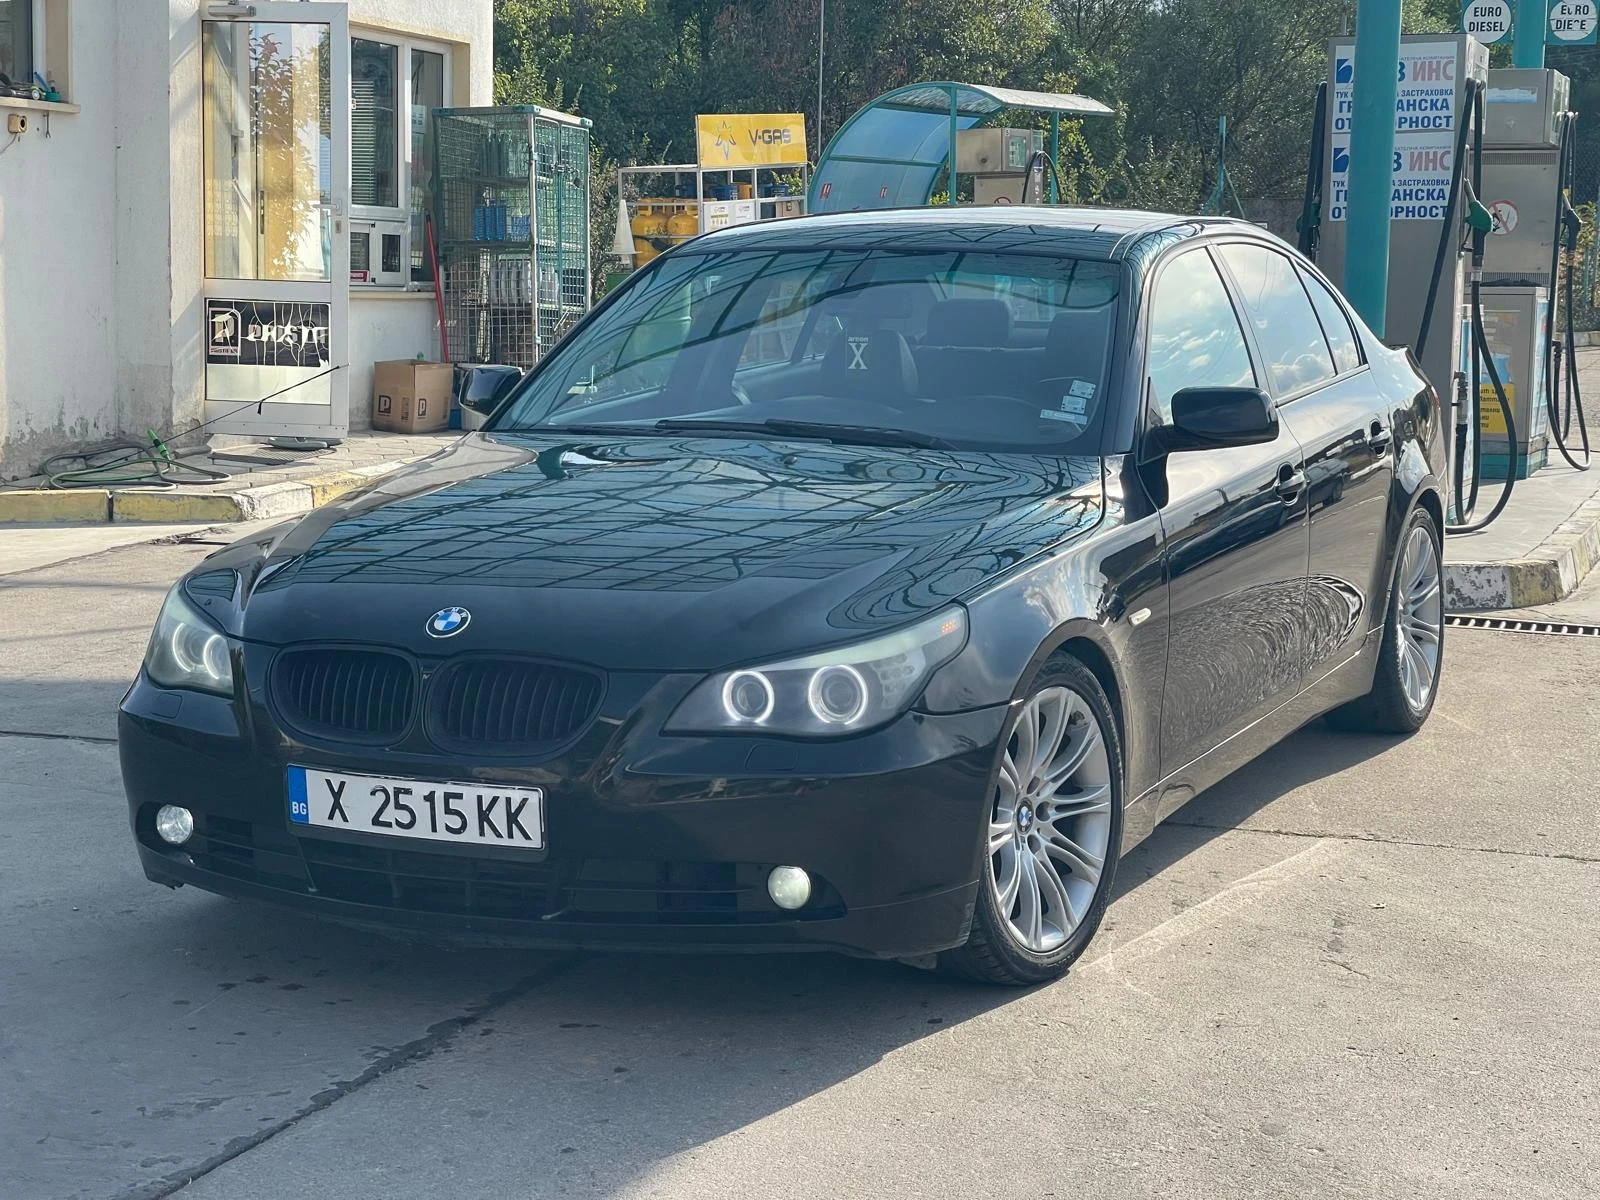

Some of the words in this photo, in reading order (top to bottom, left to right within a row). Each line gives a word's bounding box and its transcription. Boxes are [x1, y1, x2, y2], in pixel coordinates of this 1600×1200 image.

[1473, 7, 1502, 17] EURO
[1468, 21, 1505, 32] DIESEL
[1412, 61, 1454, 82] ИНС
[1401, 88, 1454, 97] ЗАСТРАХОВКА
[1409, 151, 1451, 171] ИНС
[1398, 179, 1450, 187] ЗАСТРАХОВКА
[848, 343, 868, 369] X
[292, 801, 307, 814] BG
[325, 779, 349, 823] X
